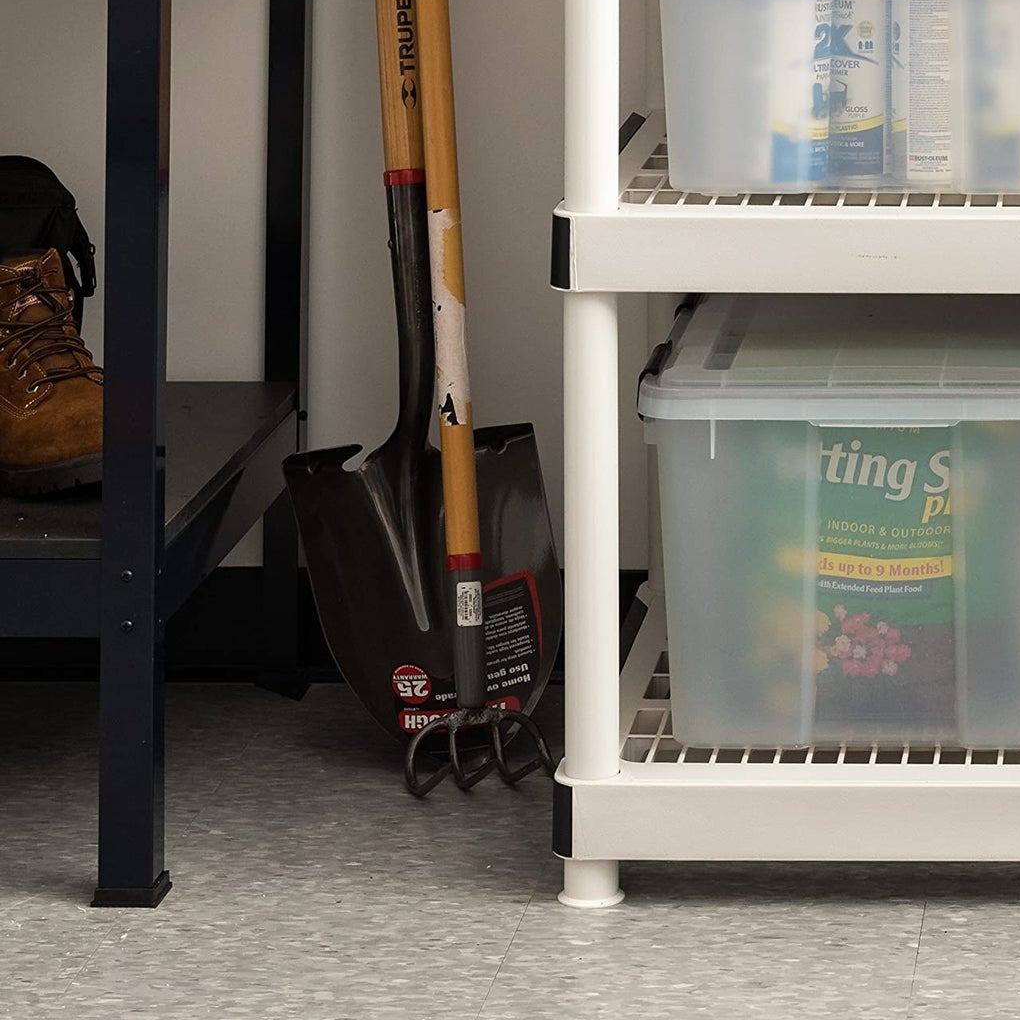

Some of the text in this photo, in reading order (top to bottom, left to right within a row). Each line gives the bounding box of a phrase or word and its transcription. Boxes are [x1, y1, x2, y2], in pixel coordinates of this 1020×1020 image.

[845, 105, 868, 113] GLOSS
[827, 520, 951, 538] INDOOR & OUTDOOR
[826, 536, 852, 545] BIGGER
[853, 540, 880, 549] PLANTS
[880, 542, 887, 550] &
[887, 543, 908, 551] MORE
[838, 563, 855, 576] up
[858, 564, 872, 576] to
[876, 565, 885, 577] 9
[889, 560, 945, 577] Months!
[832, 581, 865, 593] Extended
[865, 585, 883, 594] Feed
[883, 584, 904, 594] Plant
[904, 583, 922, 593] Food
[487, 663, 529, 680] Uso gen
[397, 680, 429, 697] 25
[501, 673, 531, 688] Home
